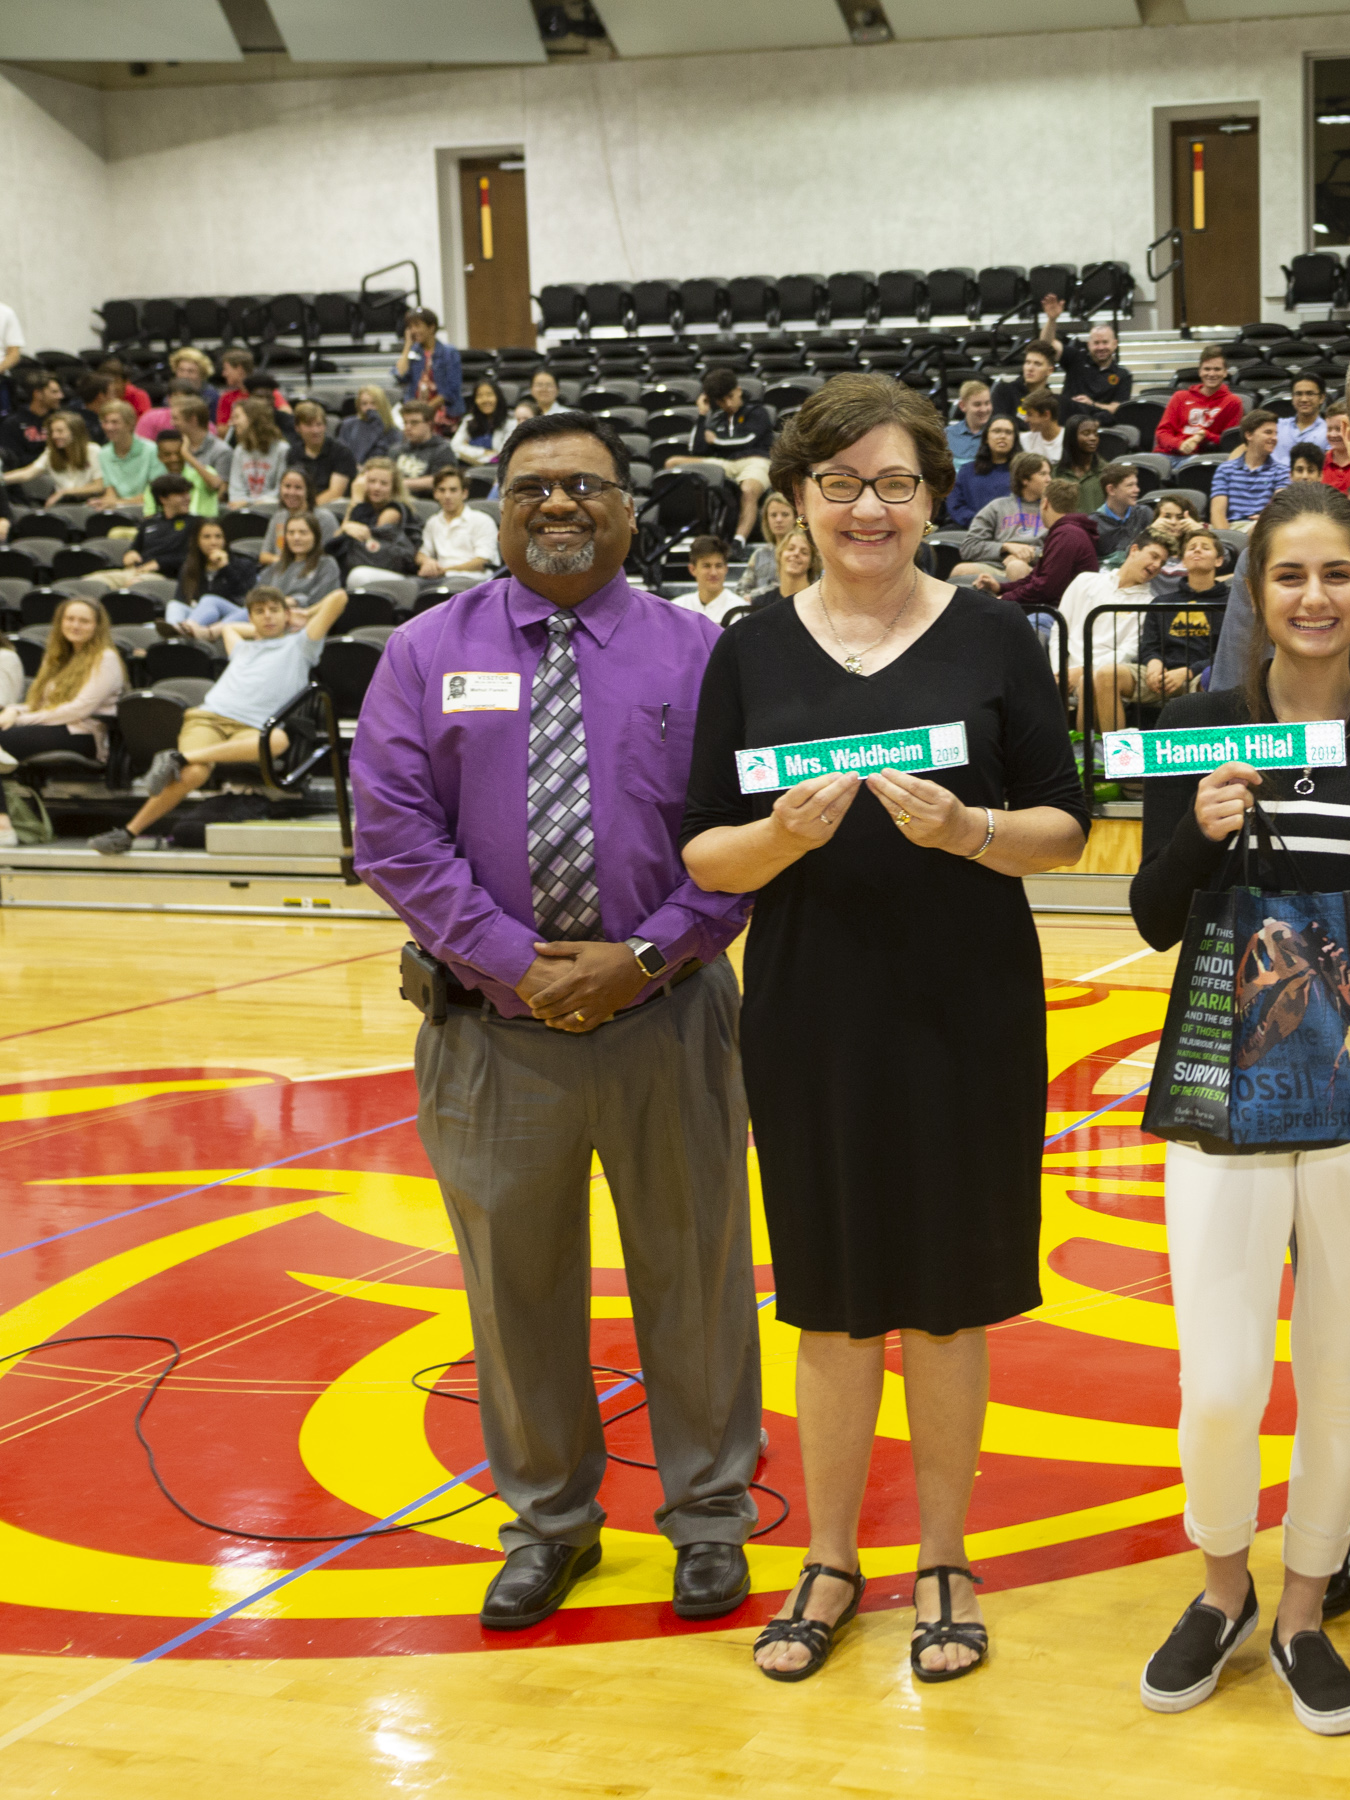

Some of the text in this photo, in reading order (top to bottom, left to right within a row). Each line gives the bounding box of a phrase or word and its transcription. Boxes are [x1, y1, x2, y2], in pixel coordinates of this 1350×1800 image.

[936, 746, 960, 763] 2019
[1156, 732, 1294, 764] Hannah Hilal
[1311, 746, 1337, 761] 2019
[784, 741, 923, 777] Mrs. Waldheim
[1200, 939, 1213, 951] OF
[1184, 1010, 1203, 1021] AND
[1204, 1013, 1218, 1024] THE
[1181, 1023, 1195, 1033] OF
[1196, 1025, 1222, 1038] THOSE
[1169, 1084, 1182, 1096] OF
